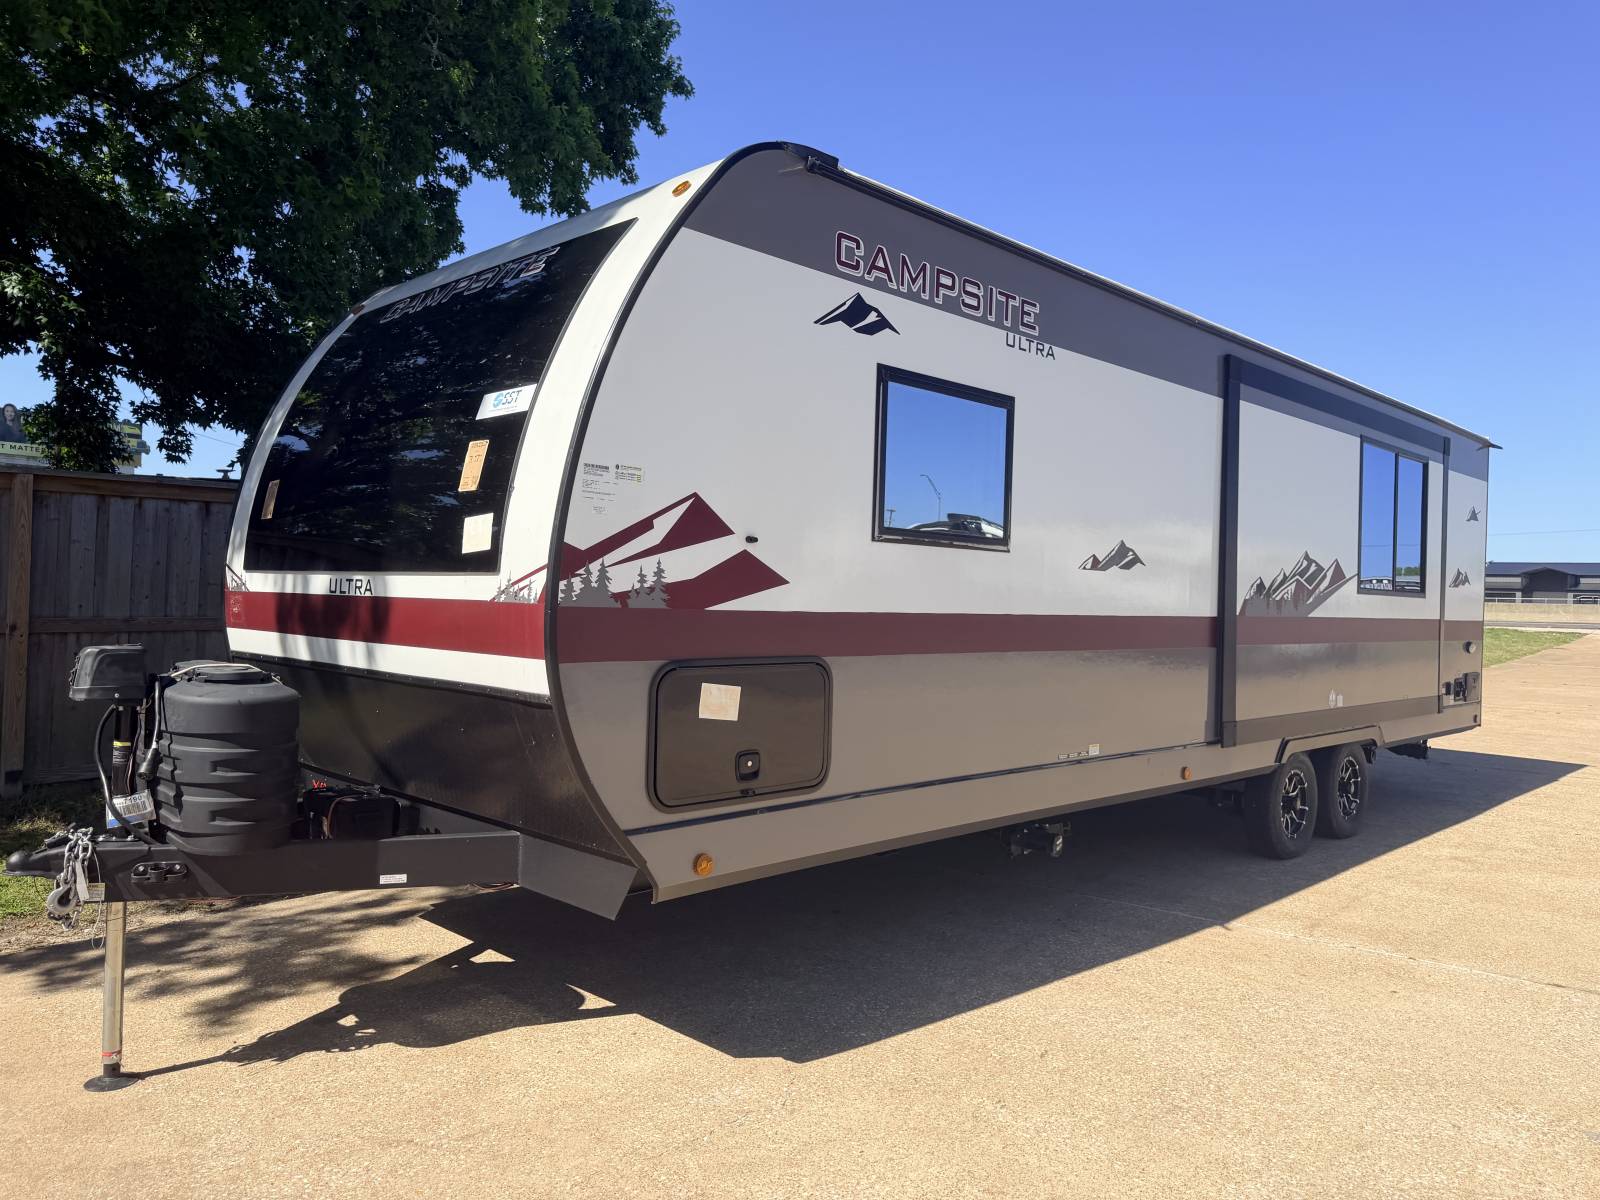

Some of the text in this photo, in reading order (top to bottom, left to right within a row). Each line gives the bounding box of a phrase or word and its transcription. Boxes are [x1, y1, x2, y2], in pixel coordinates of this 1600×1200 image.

[379, 247, 561, 324] CAMPSITE
[835, 230, 1040, 337] CAMPSITE
[1005, 331, 1056, 361] ULTRA
[328, 577, 373, 596] ULTRA
